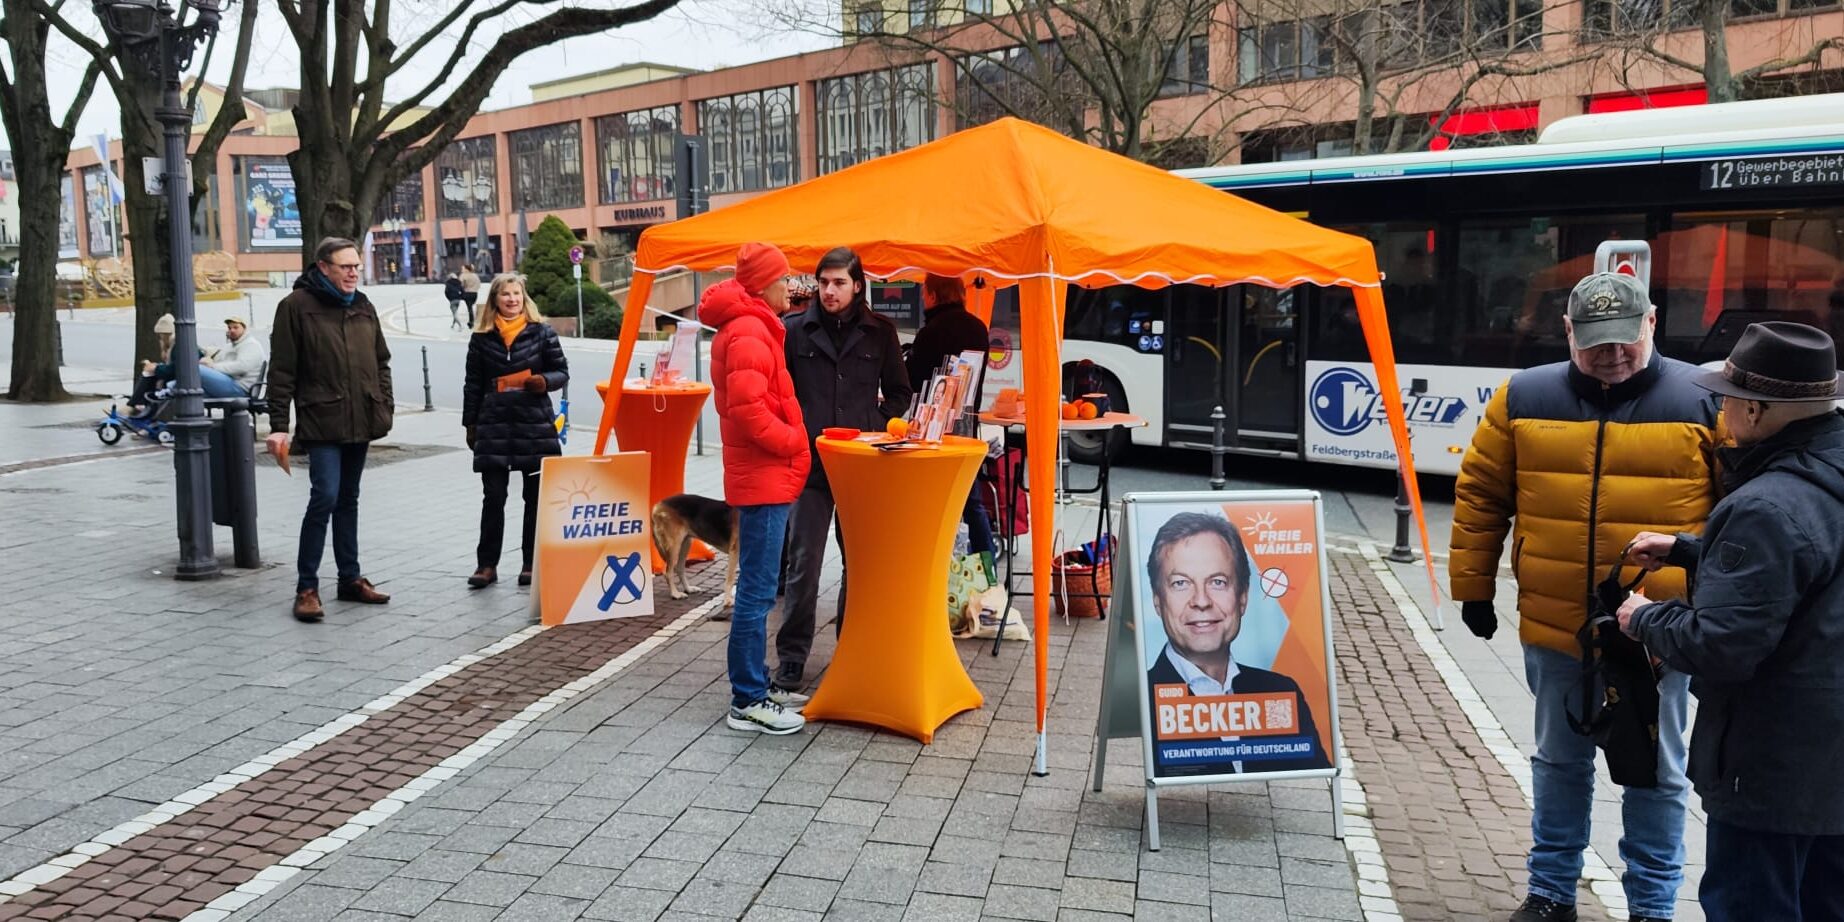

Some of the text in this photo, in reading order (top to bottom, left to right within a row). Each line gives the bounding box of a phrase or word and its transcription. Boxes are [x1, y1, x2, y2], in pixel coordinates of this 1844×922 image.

[1709, 155, 1843, 189] 12 Gewerbegebiet
[1792, 169, 1844, 183] Bahn
[1312, 444, 1397, 461] Feldbergstraße
[572, 502, 630, 520] FREIE
[563, 519, 643, 540] WÄHLER
[1259, 529, 1302, 542] FREIE
[1158, 687, 1184, 698] GUIDO
[1159, 700, 1262, 735] BECKER
[1163, 742, 1311, 759] VERANTWORTUNG FÜR DEUTSCHLAND
